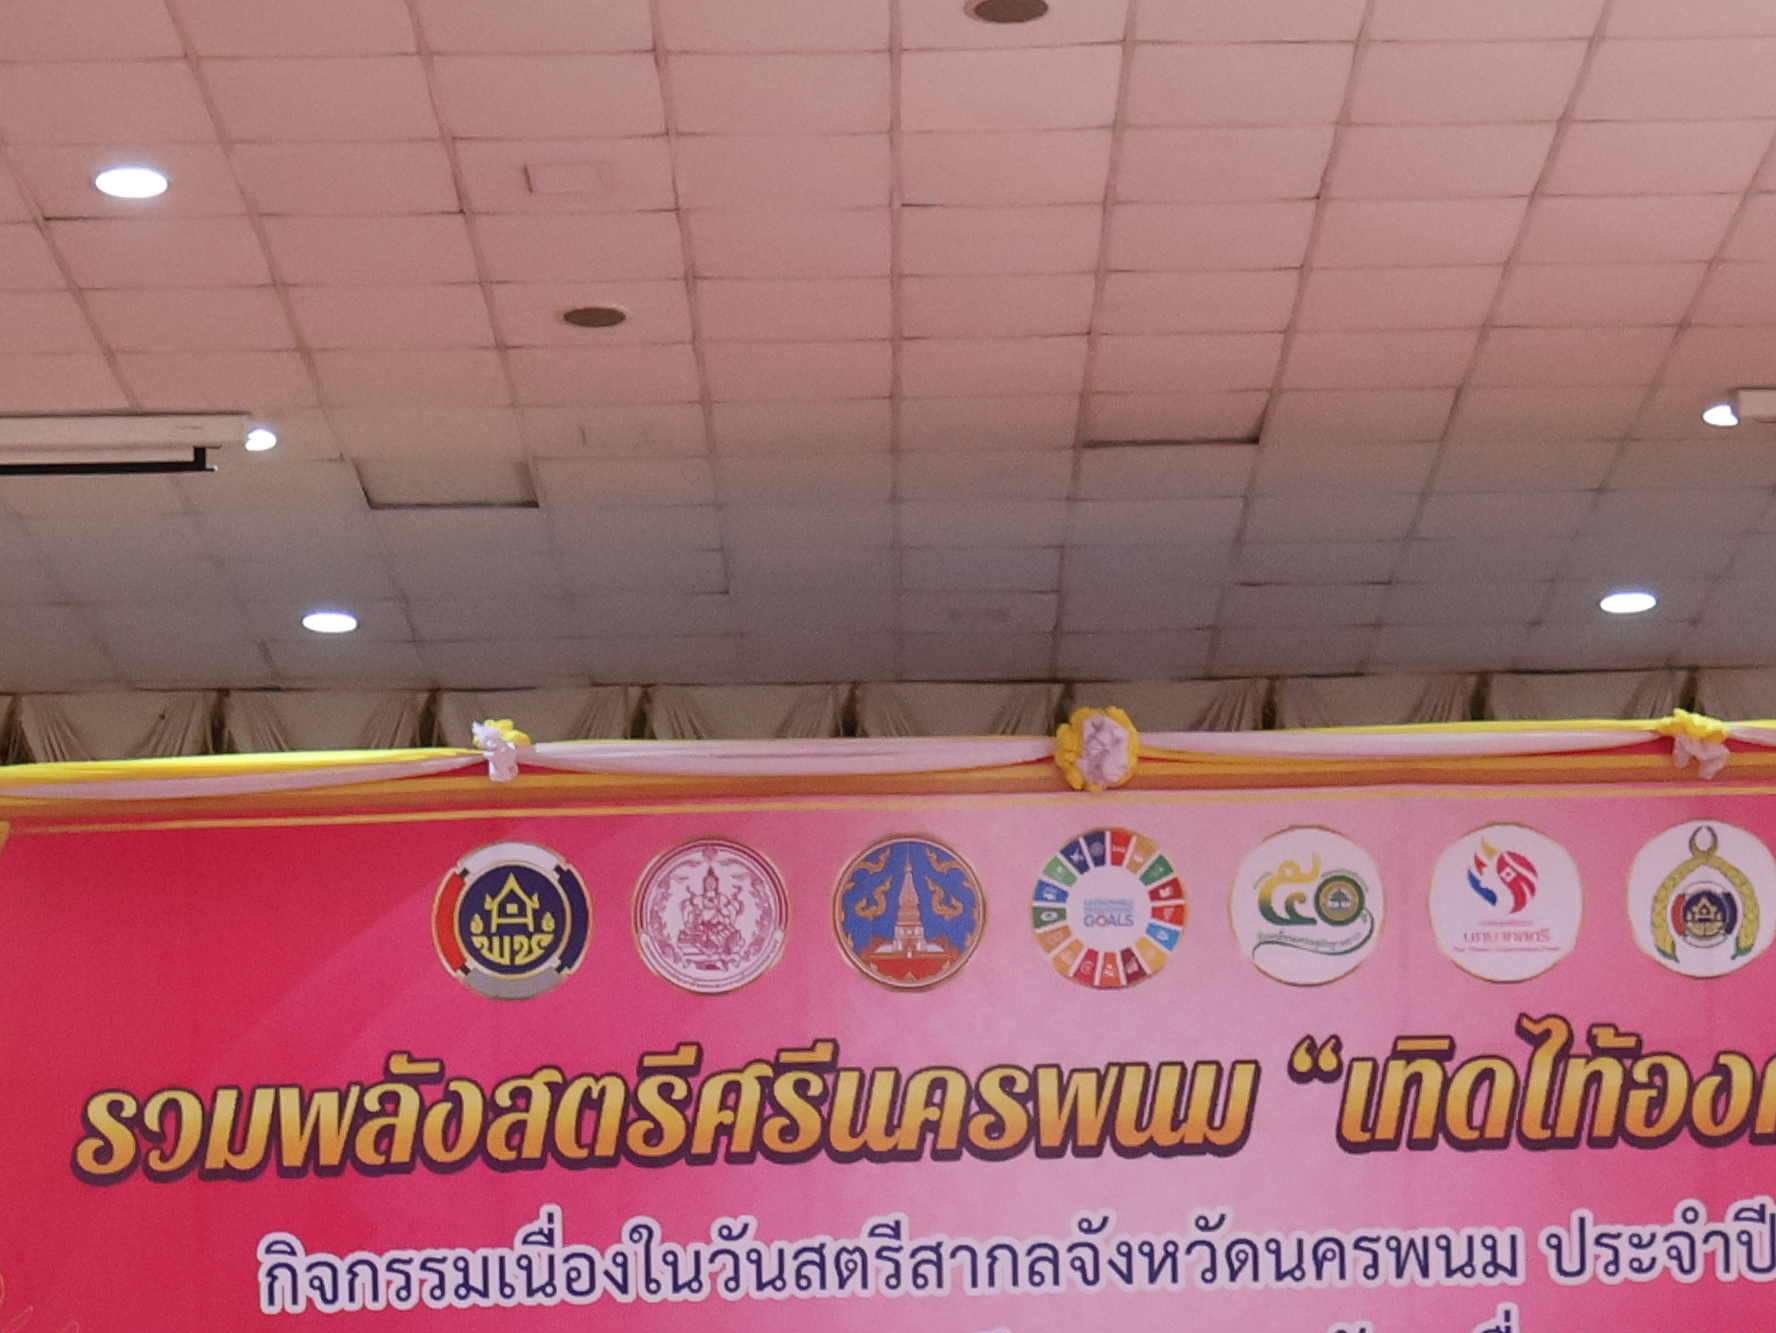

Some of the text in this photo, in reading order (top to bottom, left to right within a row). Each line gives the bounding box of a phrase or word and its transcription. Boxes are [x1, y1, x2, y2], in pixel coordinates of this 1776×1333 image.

[1084, 914, 1135, 927] GOALS
[72, 1038, 1258, 1182] รวมพลังสตรีศรีนครพนม
[259, 1210, 1521, 1308] กิจกรรมเนื่องในวันสตรีสากลจังหวัดนครพนม
